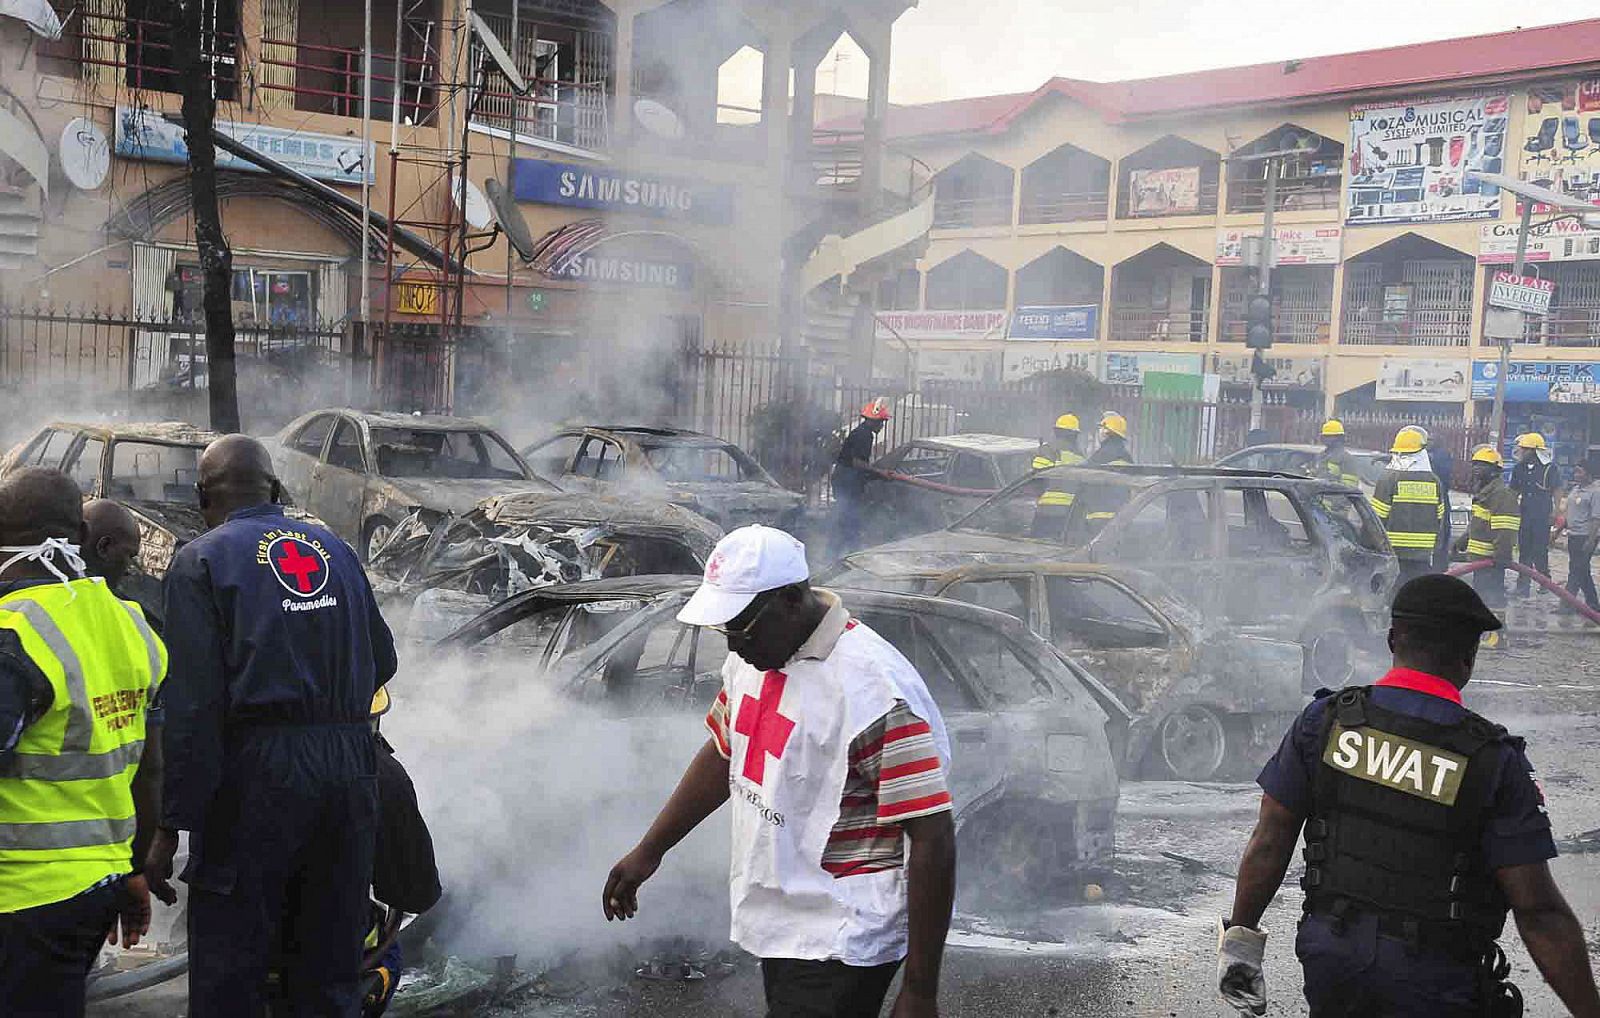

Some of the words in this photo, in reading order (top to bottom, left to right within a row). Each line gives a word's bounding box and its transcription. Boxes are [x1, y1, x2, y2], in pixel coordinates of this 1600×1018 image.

[1370, 117, 1405, 132] KOZA
[1415, 109, 1484, 127] MUSICAL
[1384, 126, 1426, 139] SYSTEMS
[1429, 123, 1466, 134] LIMITED
[559, 171, 692, 210] SAMSUNG
[570, 256, 678, 285] SAMSUNG
[1498, 271, 1551, 291] SOLAR
[1493, 285, 1549, 305] INVERTER
[256, 540, 269, 564] First
[277, 529, 307, 541] Last
[312, 540, 332, 560] Out
[282, 594, 337, 612] Paramedics
[1332, 730, 1459, 797] SWAT
